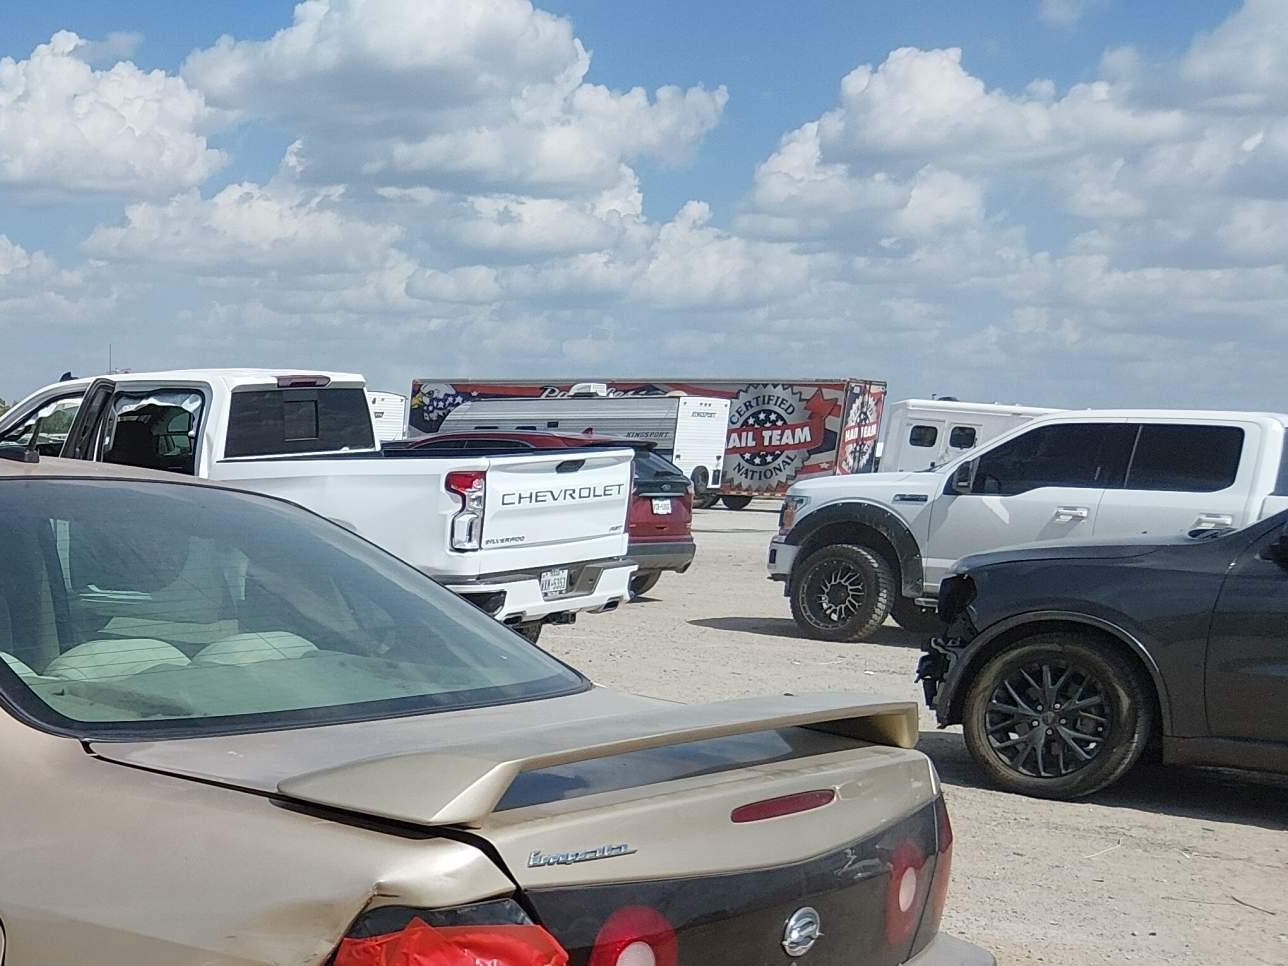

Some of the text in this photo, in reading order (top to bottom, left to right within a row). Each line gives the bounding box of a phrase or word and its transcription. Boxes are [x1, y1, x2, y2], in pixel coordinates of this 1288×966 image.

[729, 394, 795, 425] CERTIFIED
[726, 426, 811, 449] AIL TEAM
[732, 453, 797, 481] NATIONAL
[501, 483, 624, 506] CHEVROLET
